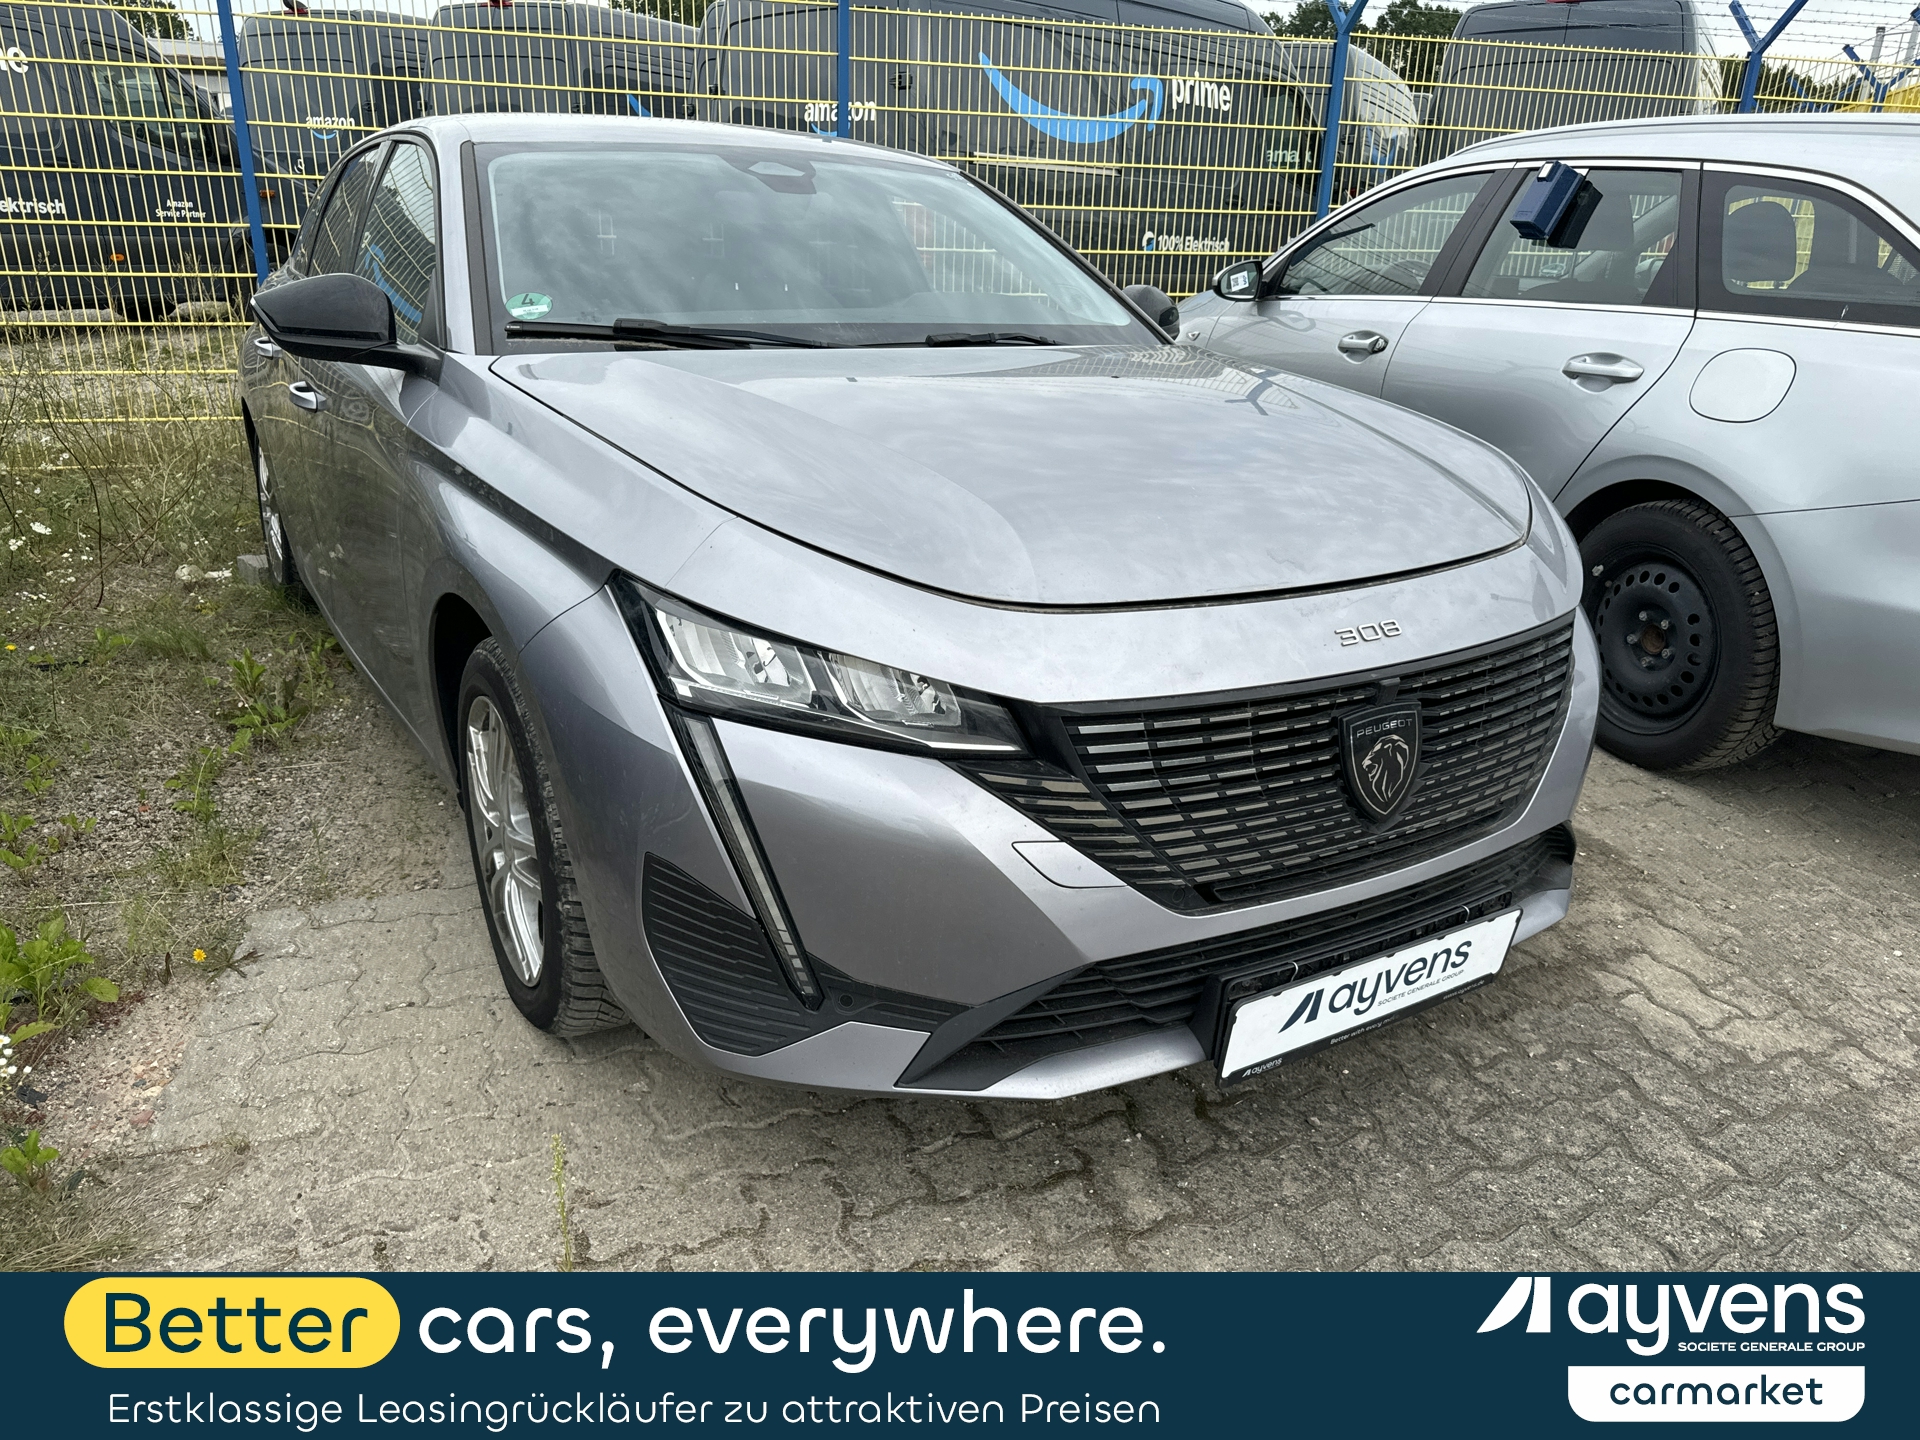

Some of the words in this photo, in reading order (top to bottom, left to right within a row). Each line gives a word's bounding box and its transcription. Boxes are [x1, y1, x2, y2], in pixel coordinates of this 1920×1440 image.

[1171, 71, 1231, 112] prime
[305, 116, 355, 129] amazon
[166, 199, 194, 208] Amazon
[155, 209, 180, 218] Service
[181, 210, 207, 219] Partner
[1157, 234, 1183, 251] 100%
[1184, 235, 1230, 253] Elektrisch
[521, 293, 535, 306] 4
[1335, 619, 1402, 647] 308
[1356, 718, 1413, 739] PEUGEOT
[1328, 940, 1472, 1016] ayvens
[1377, 991, 1407, 1007] SOCIETE
[1407, 978, 1441, 995] GENERALE
